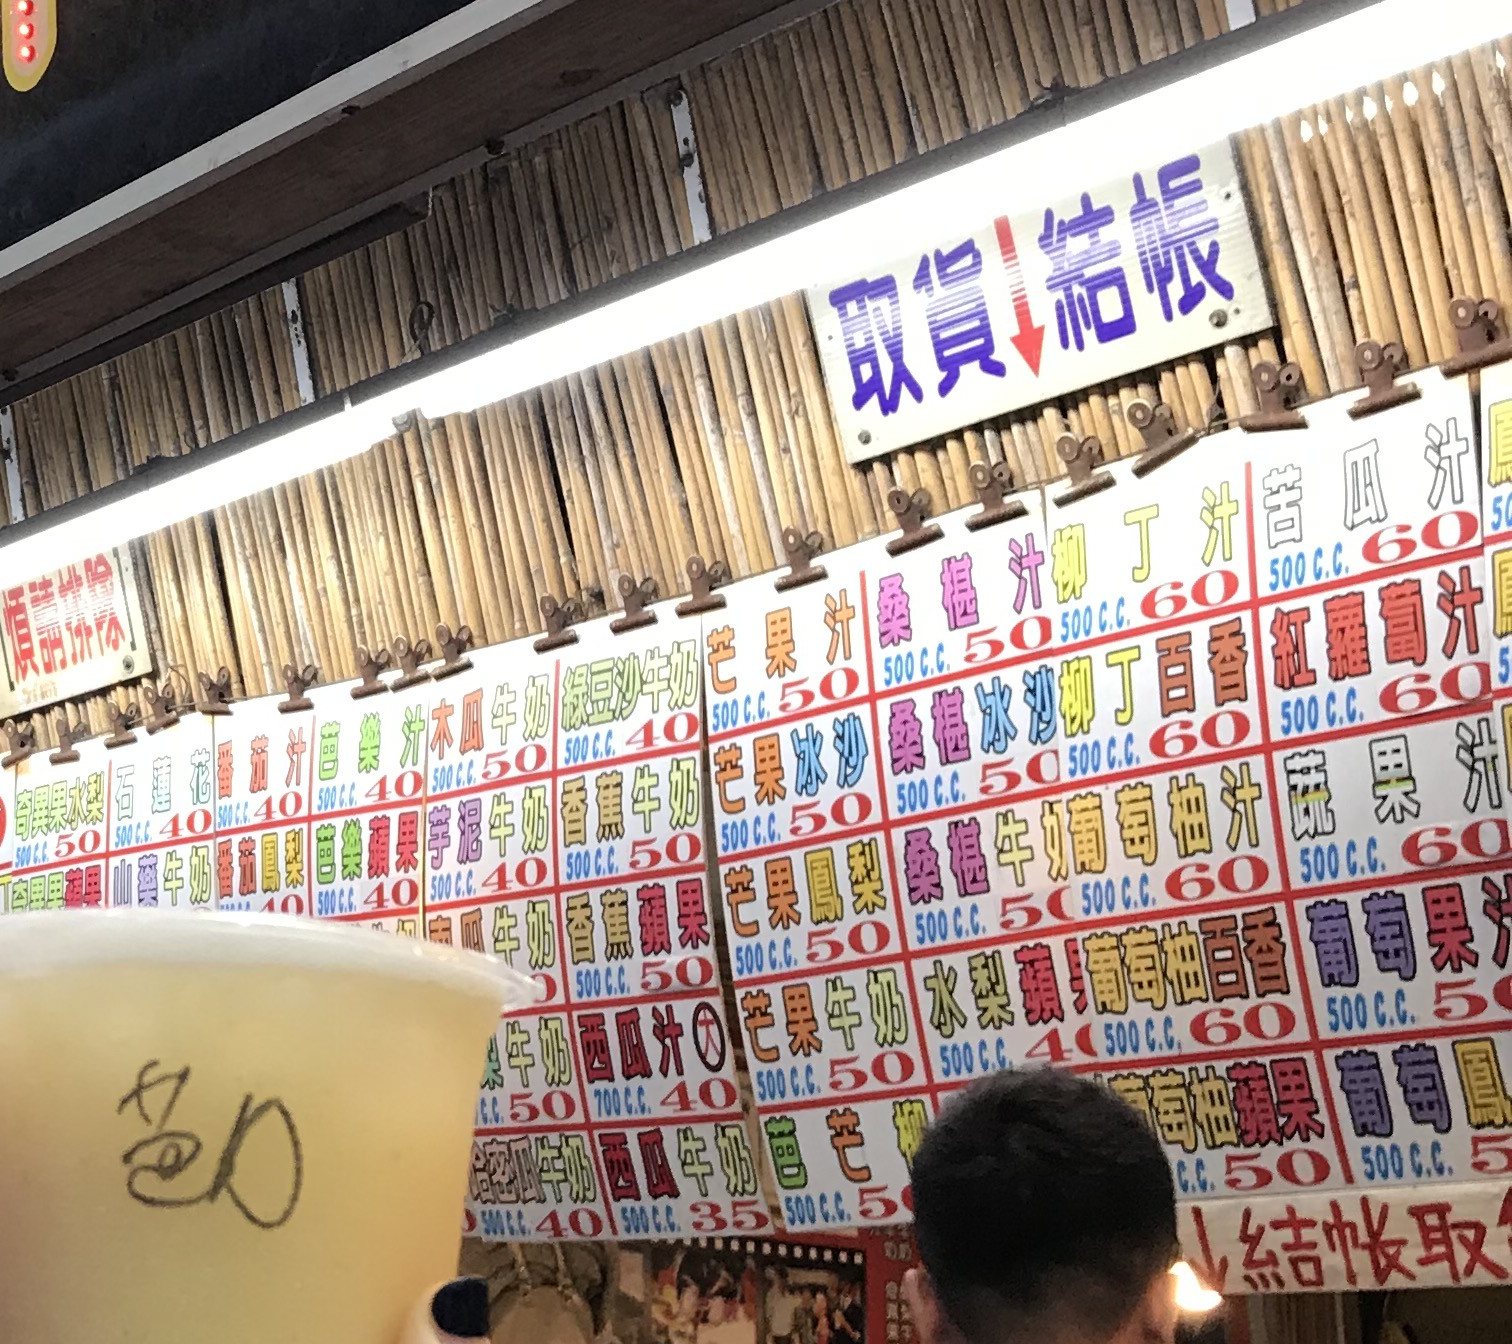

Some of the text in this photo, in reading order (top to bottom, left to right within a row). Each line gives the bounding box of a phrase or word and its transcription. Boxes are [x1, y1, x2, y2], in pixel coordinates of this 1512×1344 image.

[829, 154, 1234, 416] 取貨 結帳
[1263, 417, 1470, 549] 苦瓜汁
[1052, 481, 1238, 604] 柳丁汁
[1361, 510, 1479, 565] 60
[1140, 569, 1239, 620] 60
[707, 588, 856, 695] 芒果汁
[963, 615, 1052, 663] 50
[562, 639, 699, 733] 綠豆沙牛奶
[778, 667, 860, 713] 50
[1059, 617, 1248, 737] 柳丁百香
[1378, 661, 1492, 715] 60
[430, 673, 551, 755] 木瓜牛奶
[624, 712, 700, 752] 40
[1148, 709, 1251, 759] 60
[217, 726, 307, 799] 番茄汁
[318, 704, 426, 782] 芭樂汁
[482, 743, 548, 781] 50
[714, 713, 869, 815] 芒果冰沙
[116, 747, 212, 820] 石蓮花
[364, 770, 424, 804] 40
[979, 748, 1060, 796] 50
[1283, 717, 1503, 841] 蔬果汁
[15, 770, 105, 842] 奇異果水梨
[158, 808, 213, 840] 40
[253, 790, 303, 821] 40
[428, 785, 549, 871] 芋泥牛奶
[562, 756, 701, 848] 香蕉牛奶
[789, 791, 873, 838] 50
[1066, 762, 1262, 875] 葡萄柚汁
[54, 829, 102, 858] 50
[216, 828, 305, 897] 番茄鳳梨
[316, 811, 420, 886] 芭樂蘋果
[628, 833, 702, 872] 50
[1401, 817, 1512, 869] 60
[363, 877, 420, 911] 40
[481, 858, 548, 894] 40
[724, 837, 888, 937] 芒果鳳梨
[1165, 854, 1270, 903] 60
[566, 877, 710, 966] 香蕉蘋果
[806, 920, 891, 964] 50
[640, 956, 714, 992] 50
[1084, 906, 1290, 1015] 葡萄柚百香
[741, 968, 909, 1063] 芒果牛奶
[1189, 1001, 1296, 1047] 60
[660, 1078, 738, 1113] 40
[828, 1051, 916, 1092] 50
[509, 1089, 576, 1123] 50
[597, 1122, 758, 1202] 西瓜牛奶
[1224, 1148, 1331, 1192] 50
[535, 1208, 603, 1240] 40
[690, 1200, 770, 1233] 35
